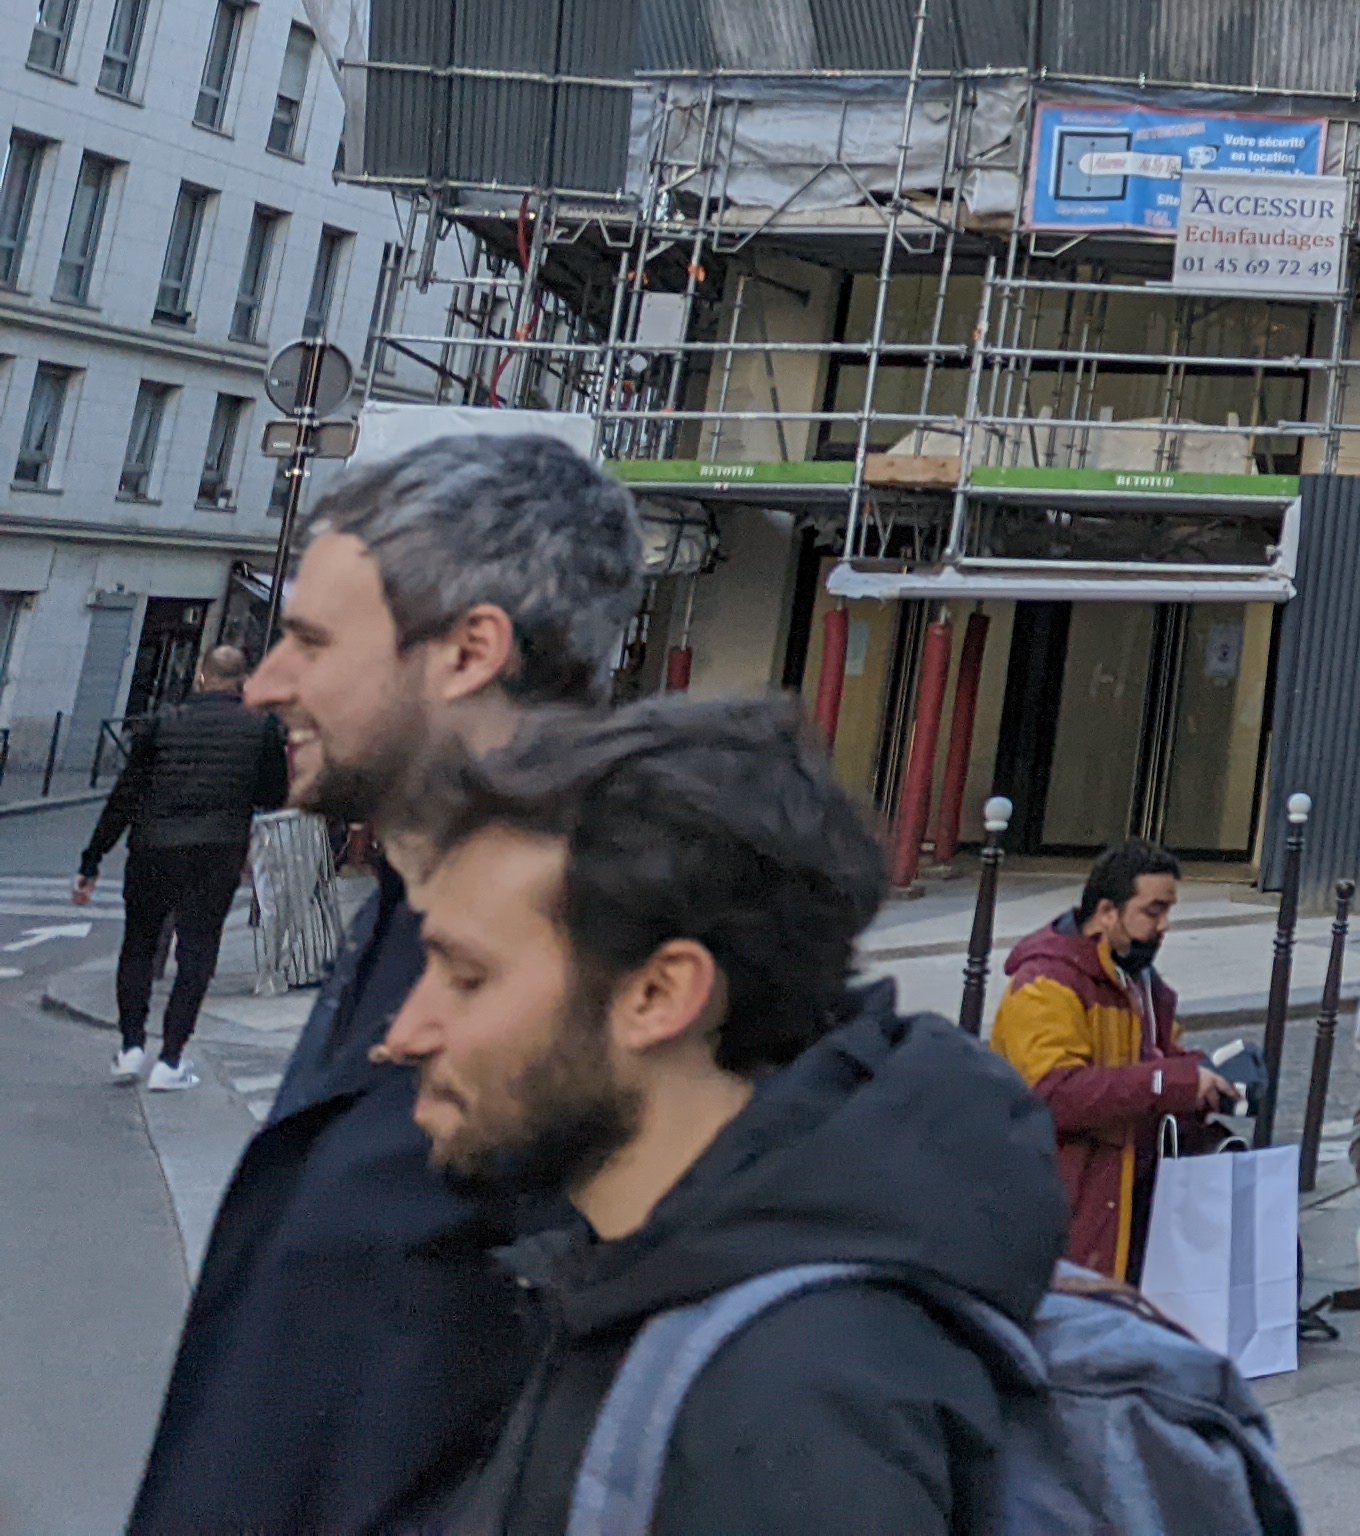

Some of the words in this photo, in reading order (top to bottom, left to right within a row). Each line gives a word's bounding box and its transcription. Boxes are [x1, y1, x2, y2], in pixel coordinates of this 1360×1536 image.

[1224, 133, 1257, 147] Votre
[1258, 133, 1306, 149] sécurité
[1230, 151, 1247, 162] en
[1248, 150, 1296, 164] location
[1190, 187, 1335, 219] ACCESSUR
[1185, 225, 1336, 251] Echafaudages
[1182, 256, 1204, 272] 01
[1214, 257, 1238, 273] 45
[1245, 256, 1270, 274] 69
[1278, 259, 1301, 275] 72
[1308, 260, 1332, 276] 49
